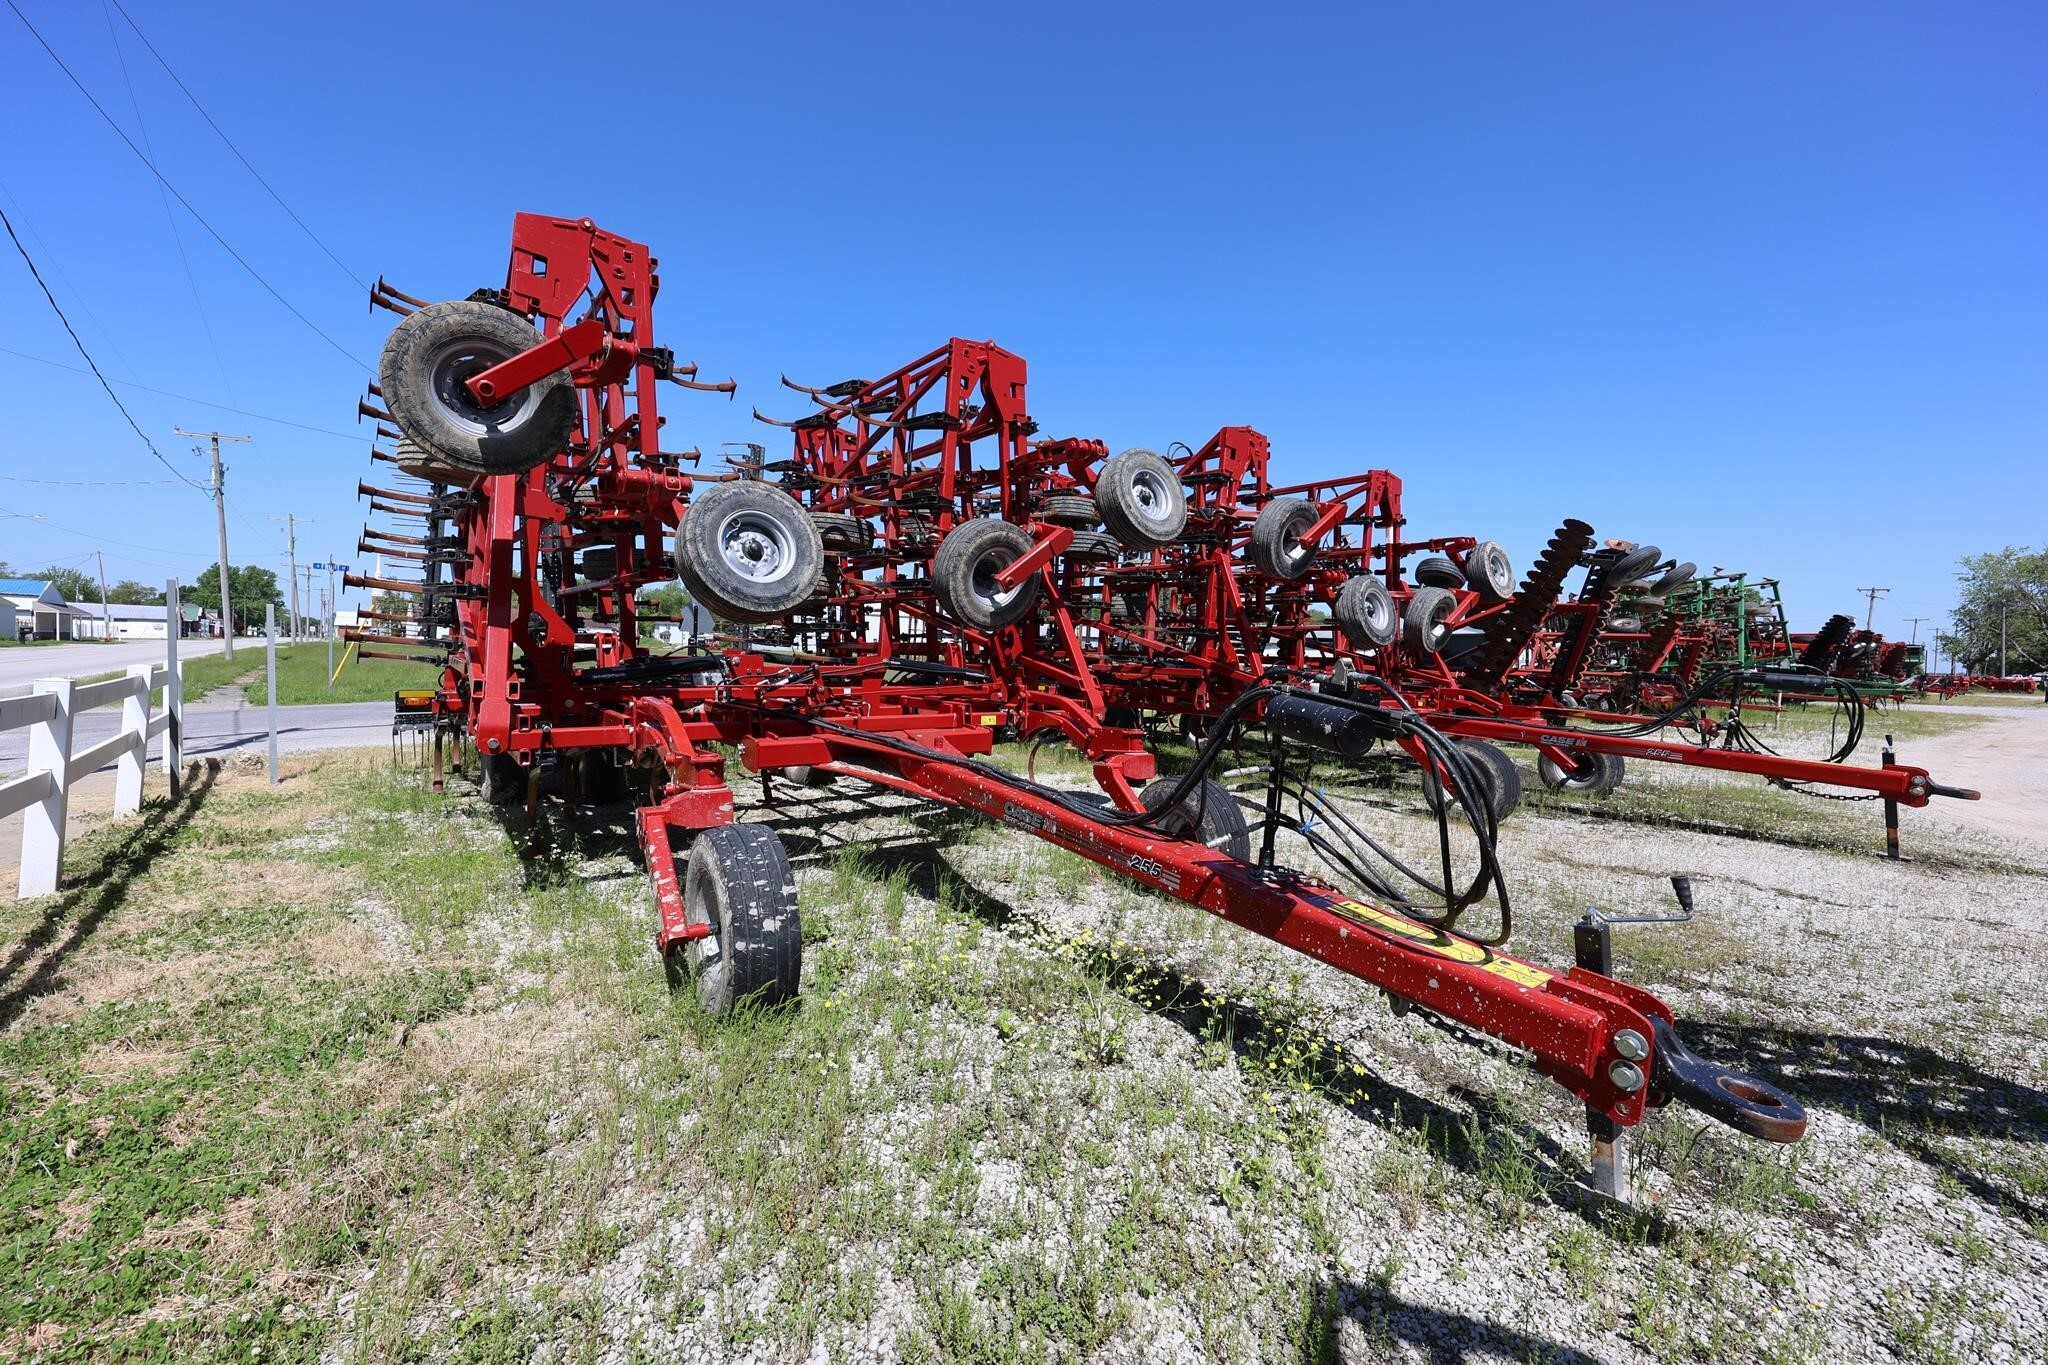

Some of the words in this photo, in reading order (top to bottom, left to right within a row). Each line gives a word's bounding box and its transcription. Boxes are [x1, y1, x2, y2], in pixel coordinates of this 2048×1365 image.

[1541, 734, 1575, 745] CASE
[1004, 801, 1042, 828] CASE
[1129, 854, 1162, 878] 255
